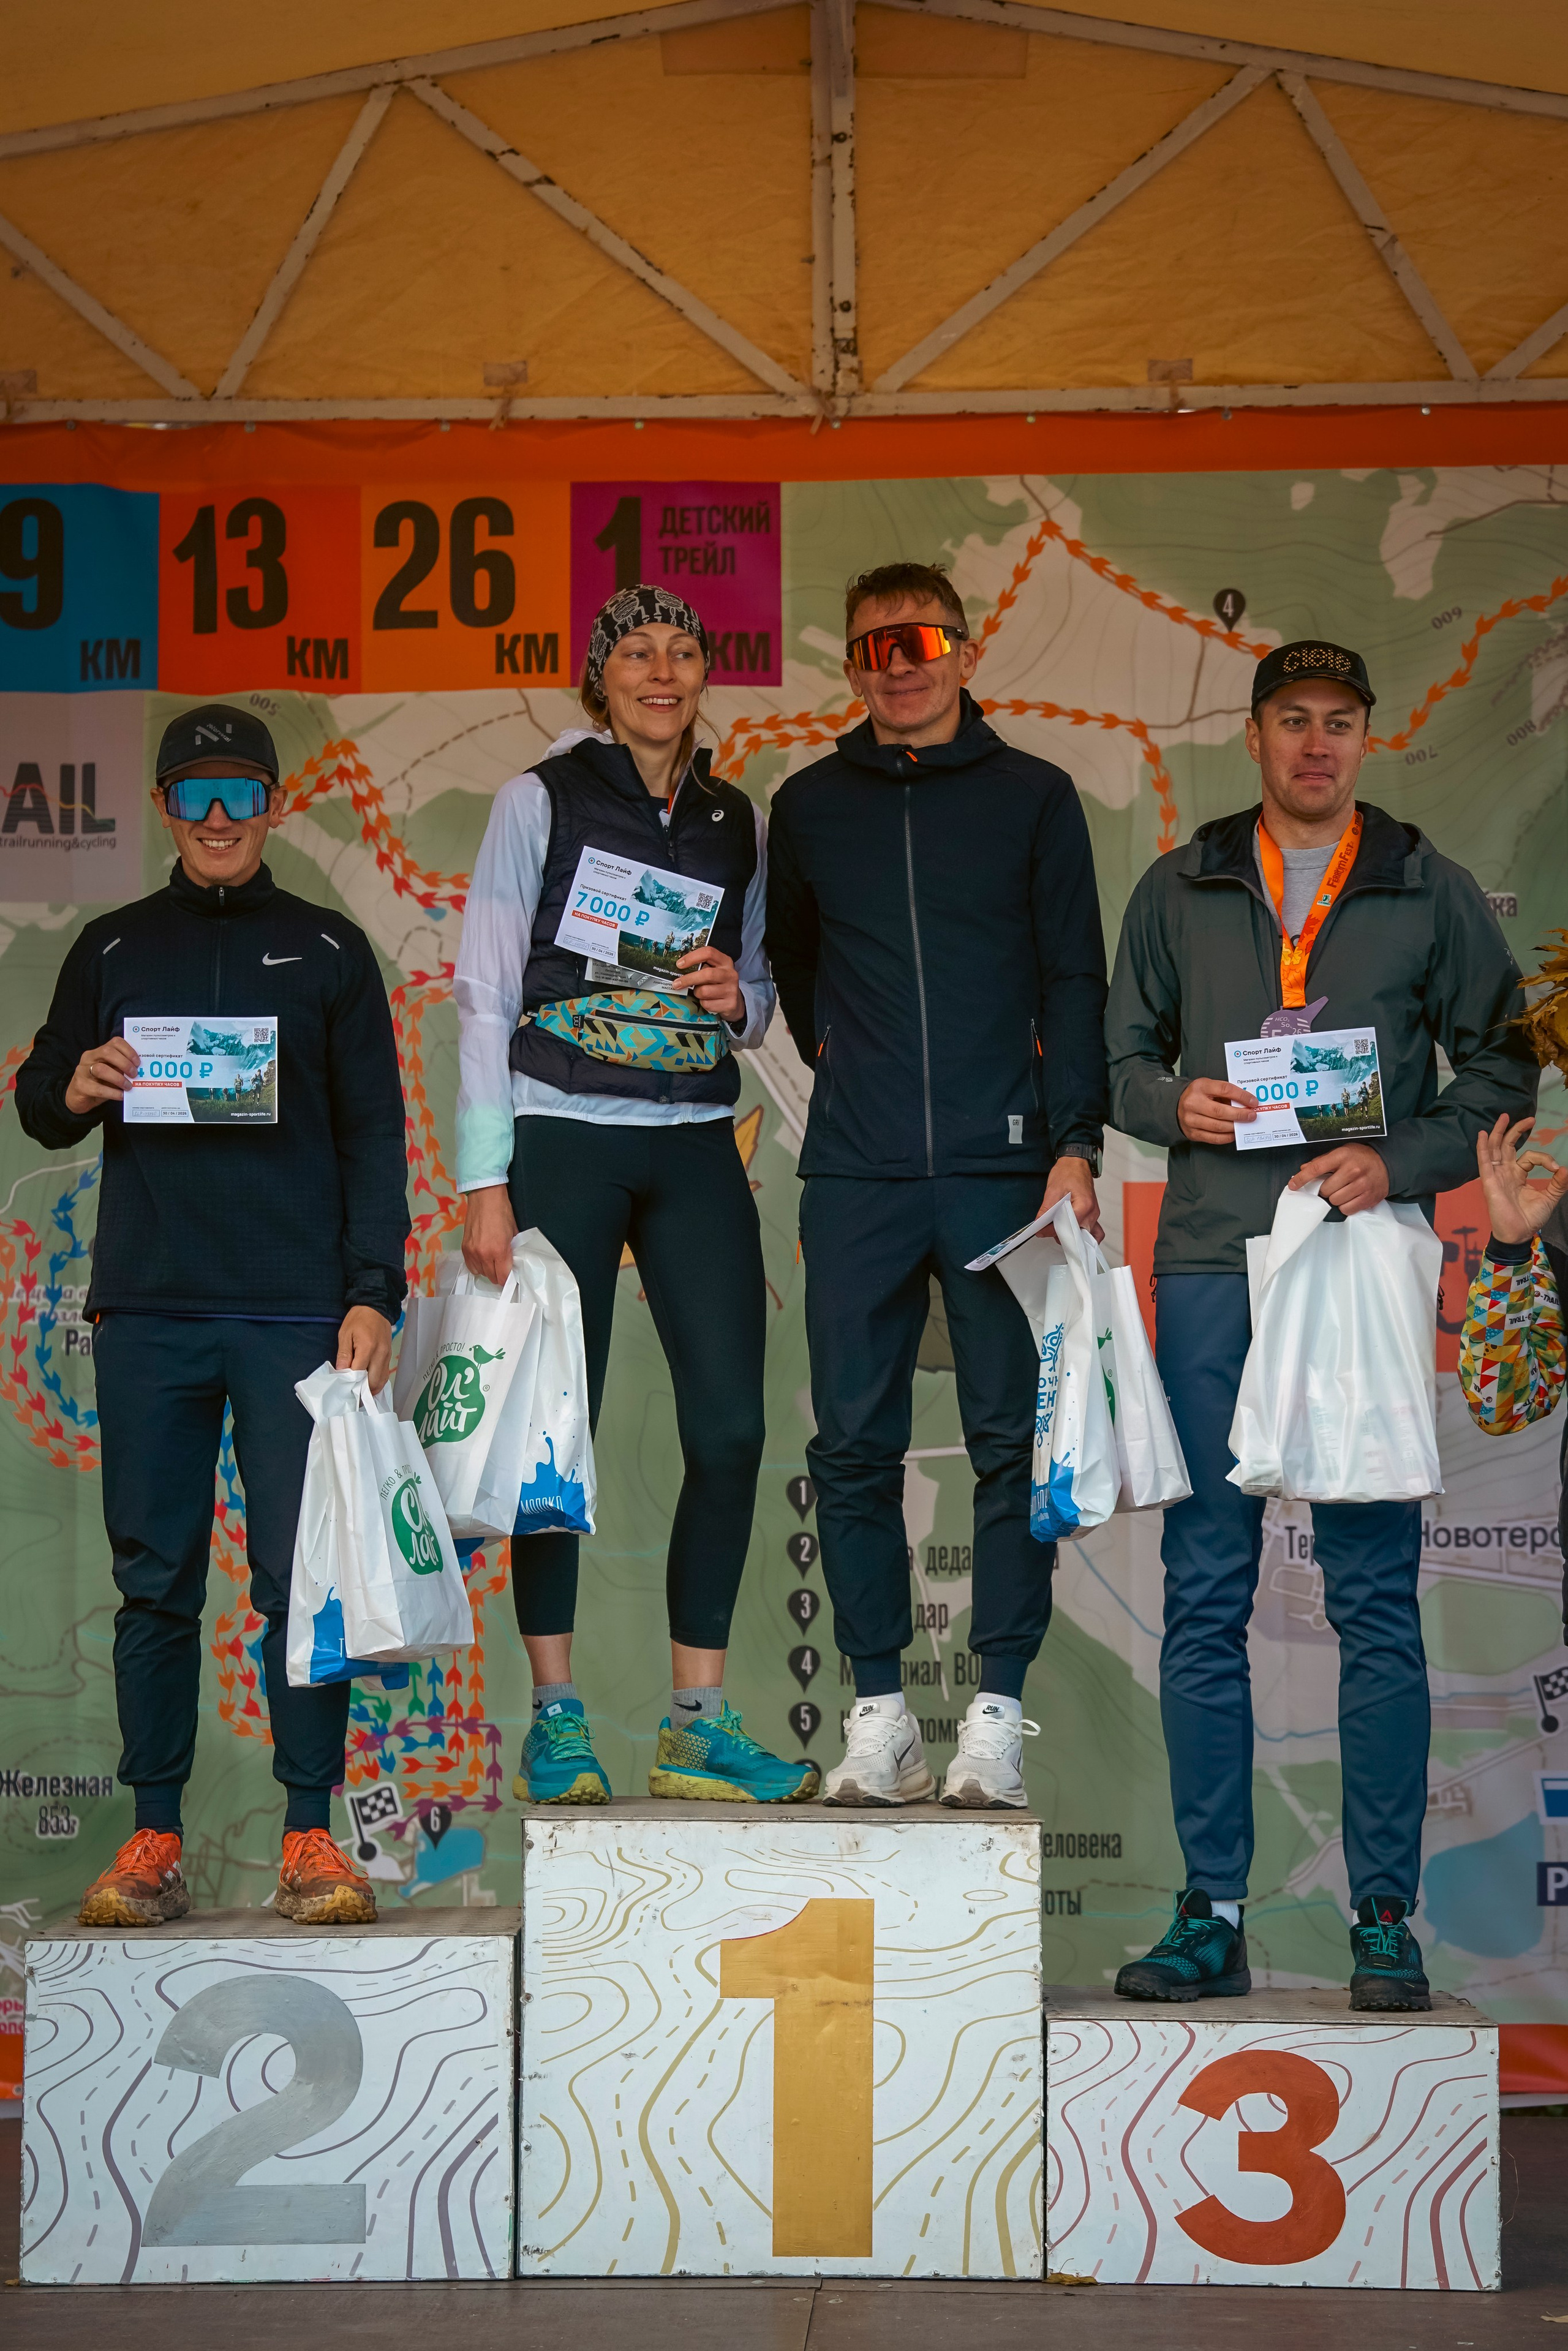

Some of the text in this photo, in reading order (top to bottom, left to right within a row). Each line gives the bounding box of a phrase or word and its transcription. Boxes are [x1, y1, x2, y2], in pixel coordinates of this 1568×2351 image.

[659, 502, 771, 534] ДЕТСКИЙ
[594, 497, 642, 592] 1
[659, 543, 736, 575] ТРЕЙЛ
[0, 498, 64, 630] 9
[172, 497, 289, 635] 13
[373, 497, 516, 630] 26
[1223, 594, 1235, 617] 4
[80, 639, 141, 681] КМ
[287, 636, 349, 679] КМ
[495, 633, 559, 674] КМ
[709, 632, 771, 673] КМ
[596, 860, 632, 875] Спорт Лайф
[580, 884, 627, 901] Призовой сертификат
[581, 913, 601, 923] ПОКУПКУ
[380, 1476, 396, 1501] ЛЕГКО
[799, 1481, 807, 1505] 1
[800, 1536, 810, 1563] 2
[925, 1545, 971, 1576] деда
[801, 1593, 810, 1619] 3
[801, 1650, 812, 1675] 4
[801, 1705, 811, 1731] 5
[862, 1704, 875, 1713] RUN
[0, 1769, 113, 1797] Железная
[430, 1808, 441, 1831] 6
[720, 1899, 875, 2258] 1
[142, 1975, 366, 2247] 2
[1174, 2048, 1346, 2265] 3
